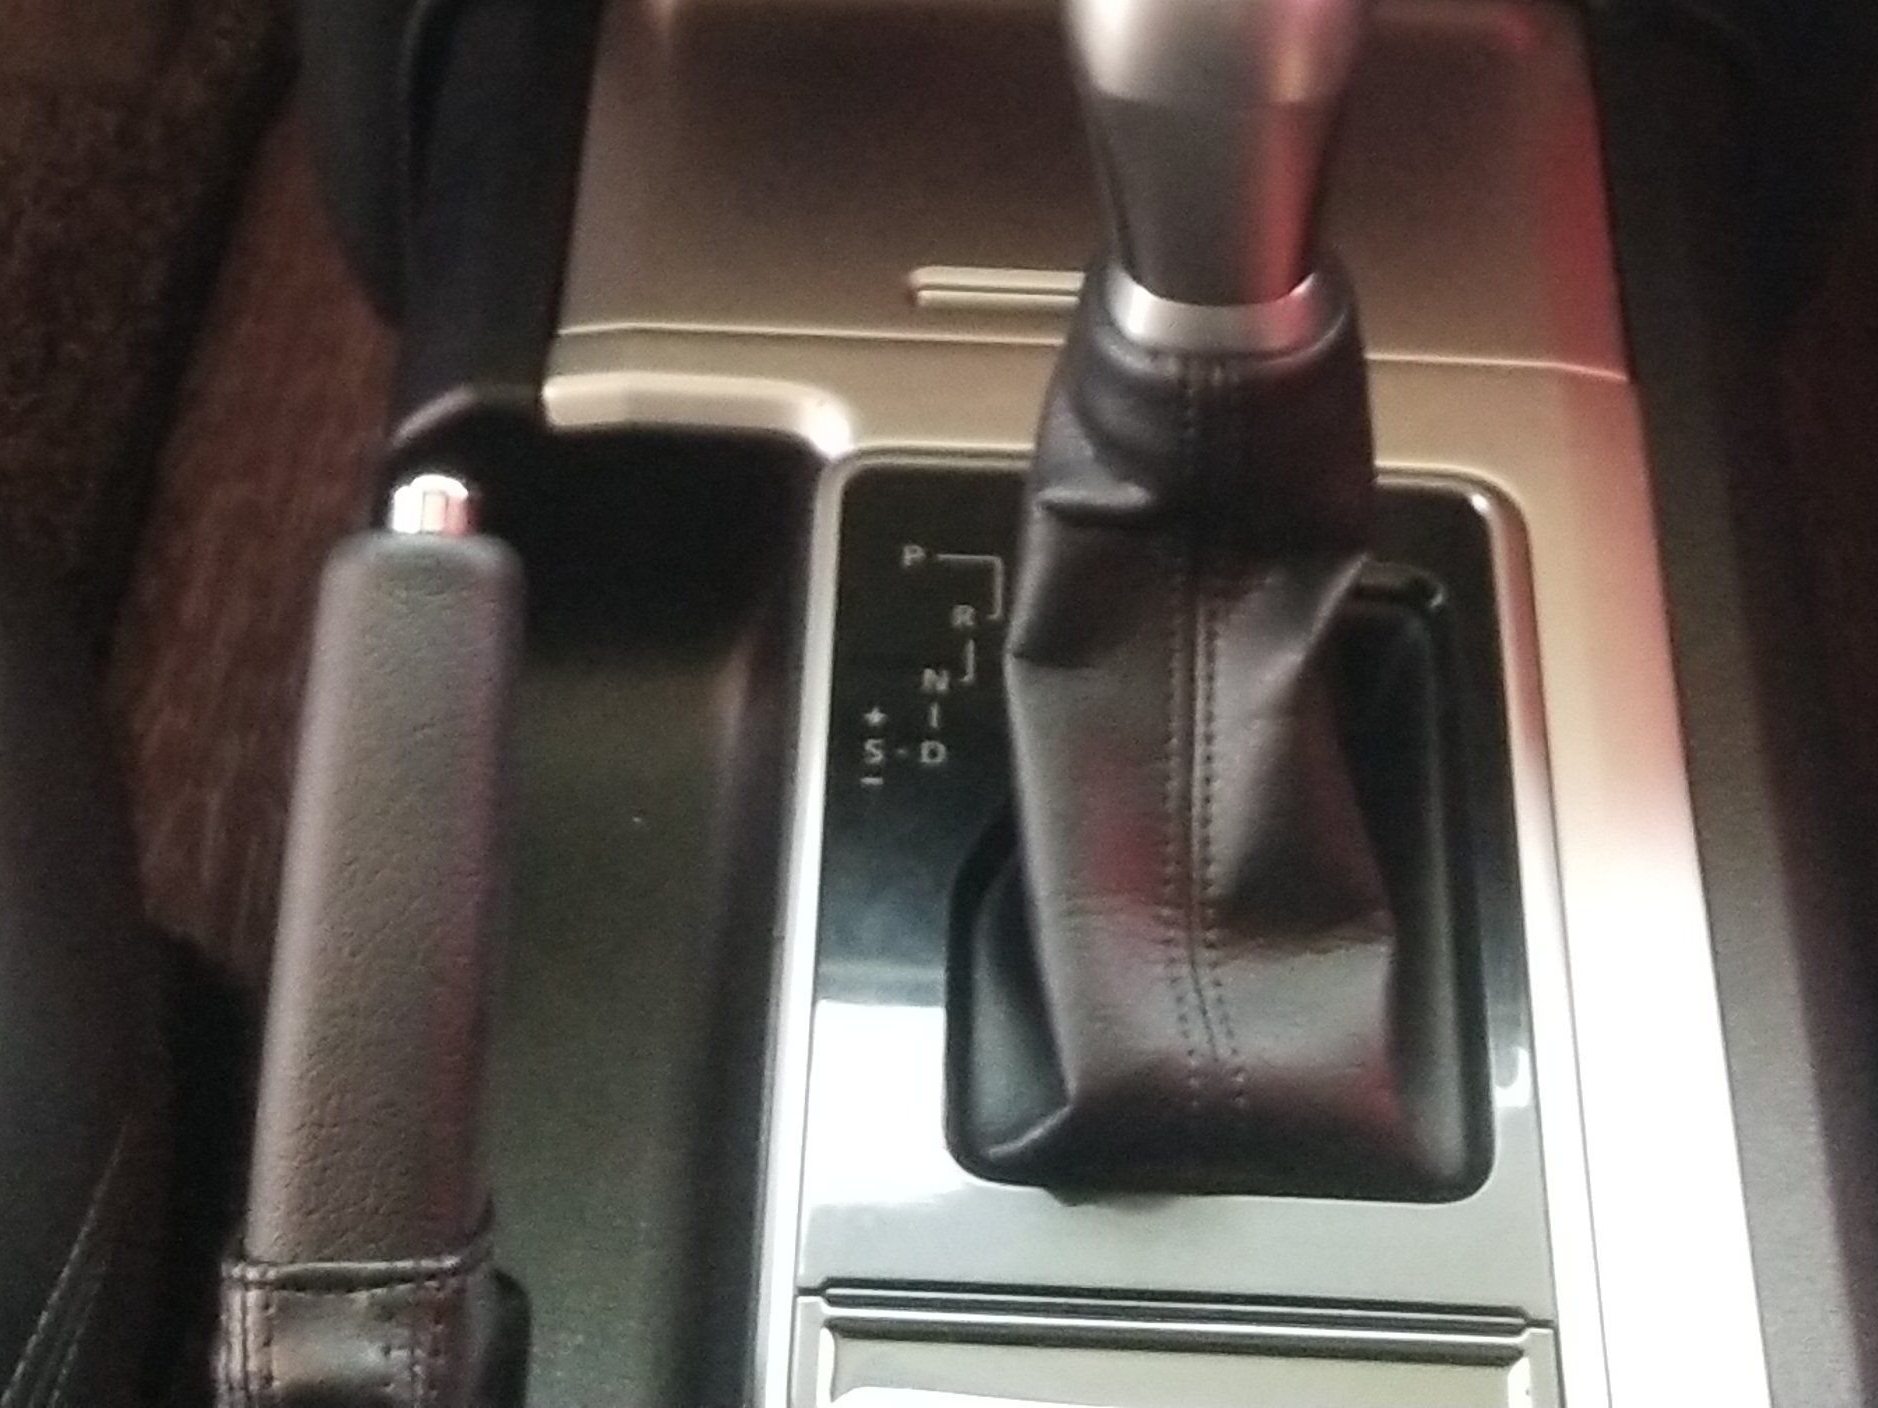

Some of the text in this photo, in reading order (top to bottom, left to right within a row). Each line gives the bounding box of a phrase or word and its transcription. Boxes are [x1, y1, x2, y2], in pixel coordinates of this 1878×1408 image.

[902, 543, 924, 567] P
[951, 604, 975, 627] R
[922, 667, 949, 693] N
[864, 739, 947, 764] S D
